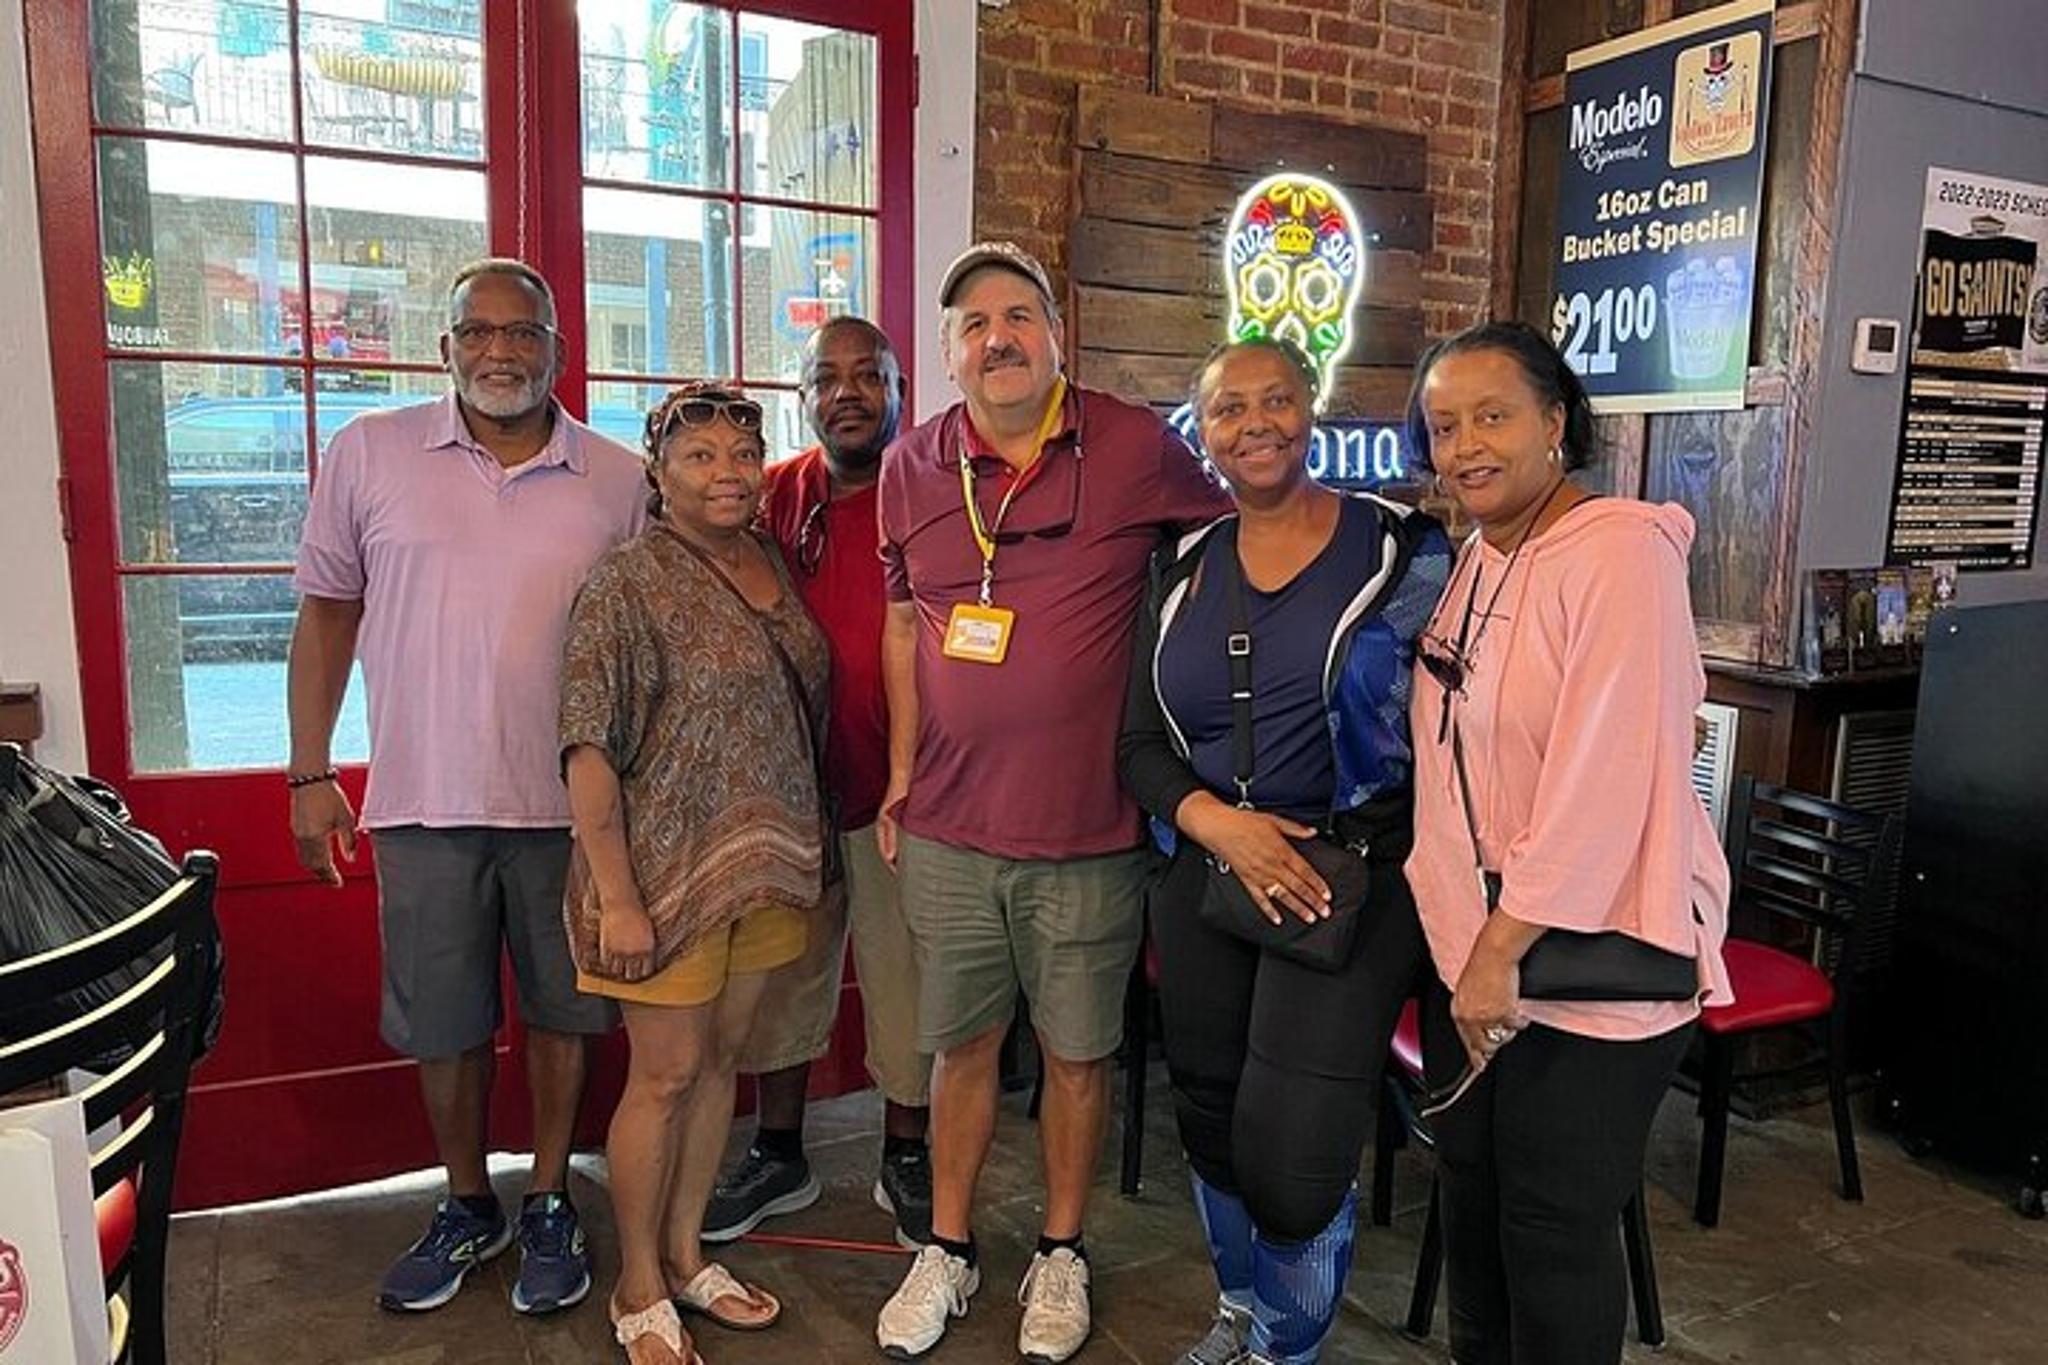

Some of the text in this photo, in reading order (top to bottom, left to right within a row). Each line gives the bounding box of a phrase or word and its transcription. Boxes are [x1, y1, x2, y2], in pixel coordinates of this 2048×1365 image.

[1569, 85, 1662, 151] Modelo
[1595, 178, 1708, 222] 16oz Can
[1939, 181, 2011, 211] 2022-2023
[1562, 206, 1748, 263] Bucket Special
[1925, 257, 1955, 318] GO
